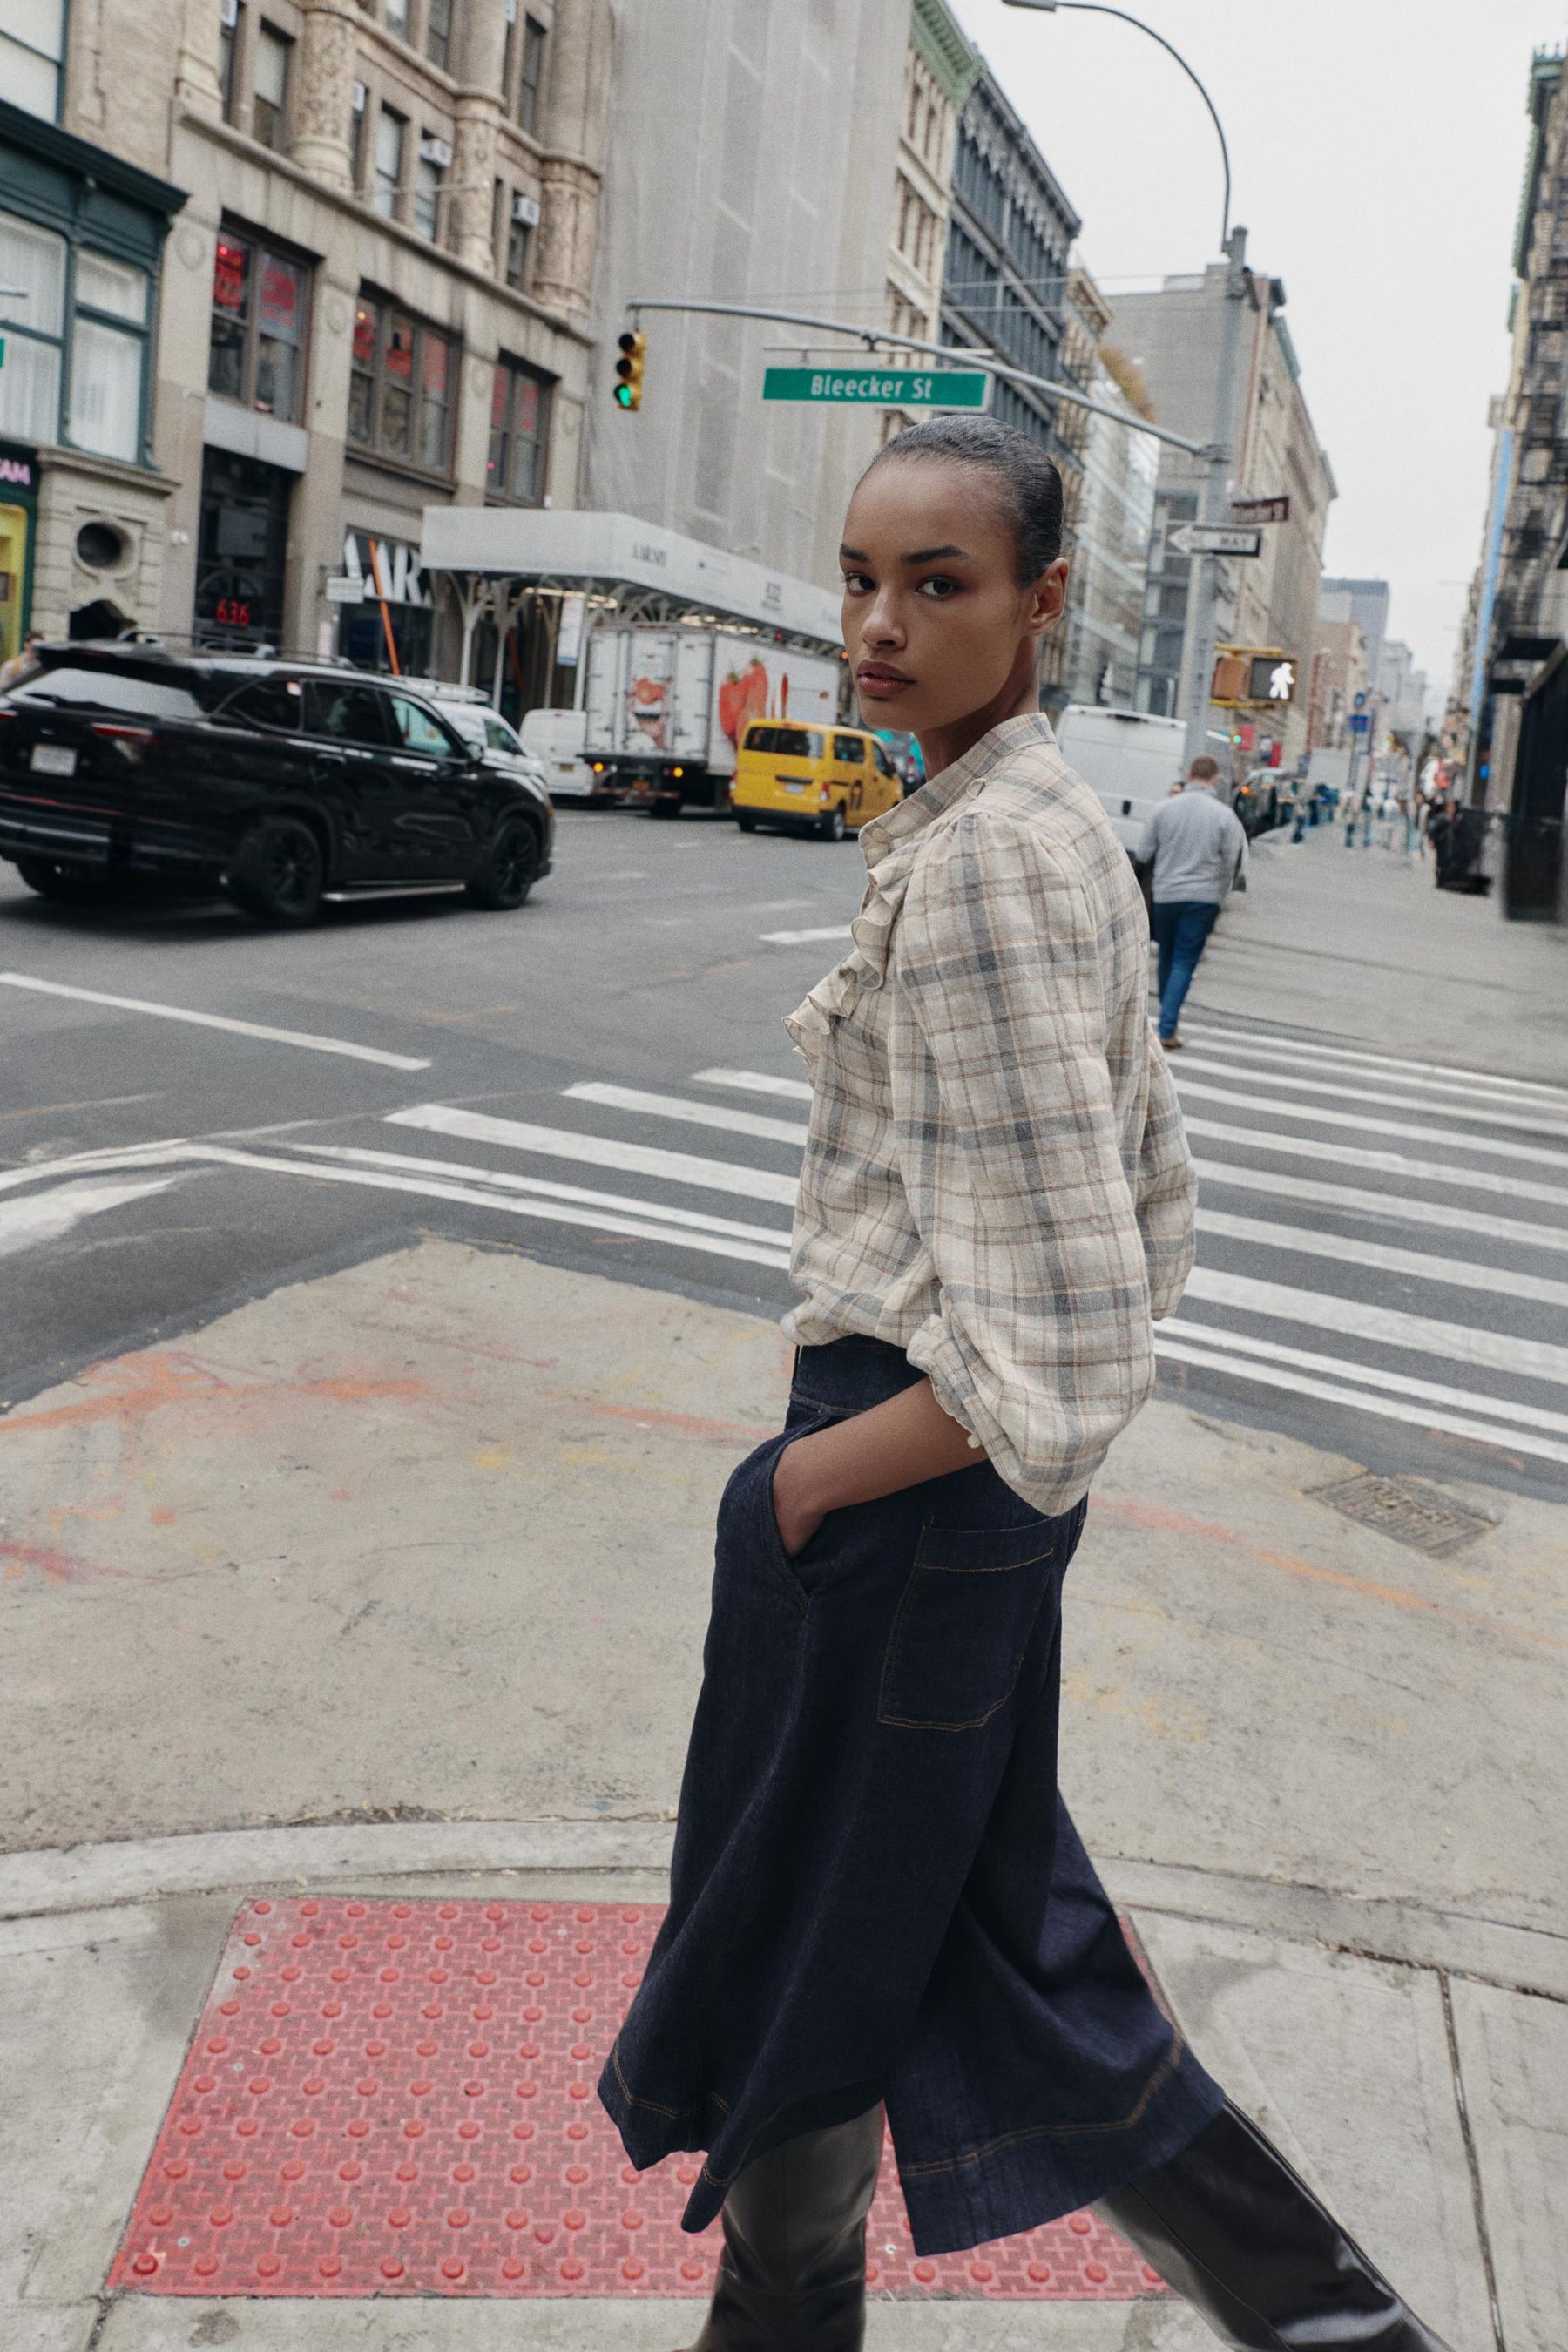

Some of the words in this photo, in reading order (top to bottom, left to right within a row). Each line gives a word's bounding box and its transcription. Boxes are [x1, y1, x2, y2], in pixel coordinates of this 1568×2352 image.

[810, 374, 904, 400] Bleecker
[911, 376, 933, 400] St
[215, 598, 252, 627] 636
